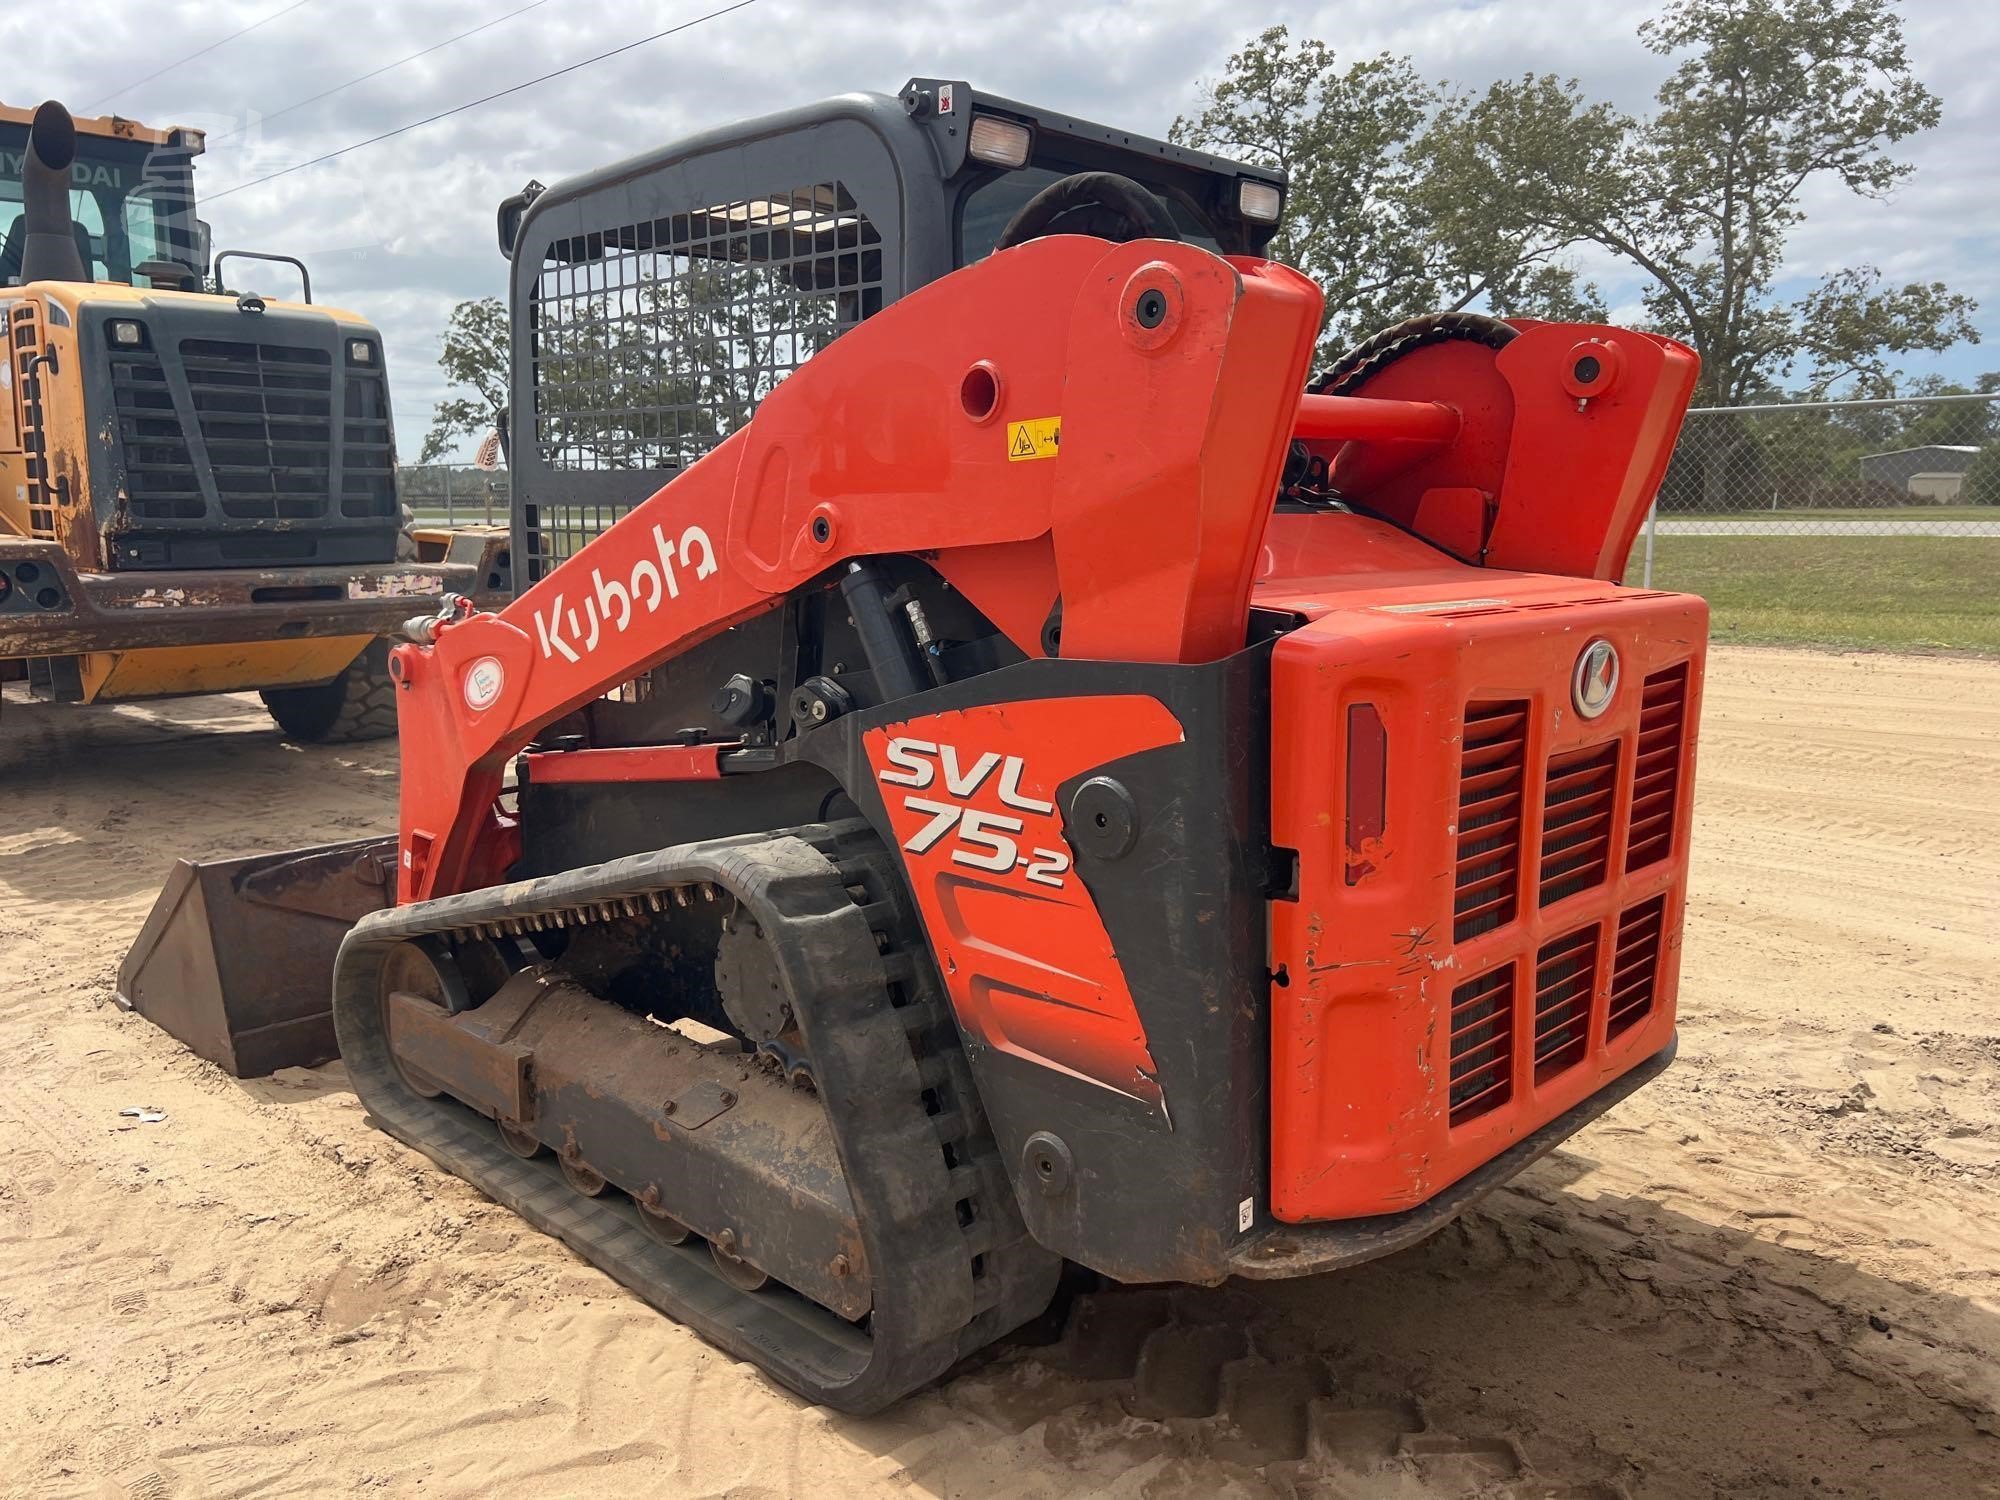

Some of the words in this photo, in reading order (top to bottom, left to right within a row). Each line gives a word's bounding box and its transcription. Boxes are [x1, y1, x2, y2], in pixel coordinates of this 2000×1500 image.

[0, 152, 120, 188] YDAI
[534, 524, 718, 664] Kubota
[879, 737, 1054, 817] SVL
[902, 796, 1070, 887] 75-2
